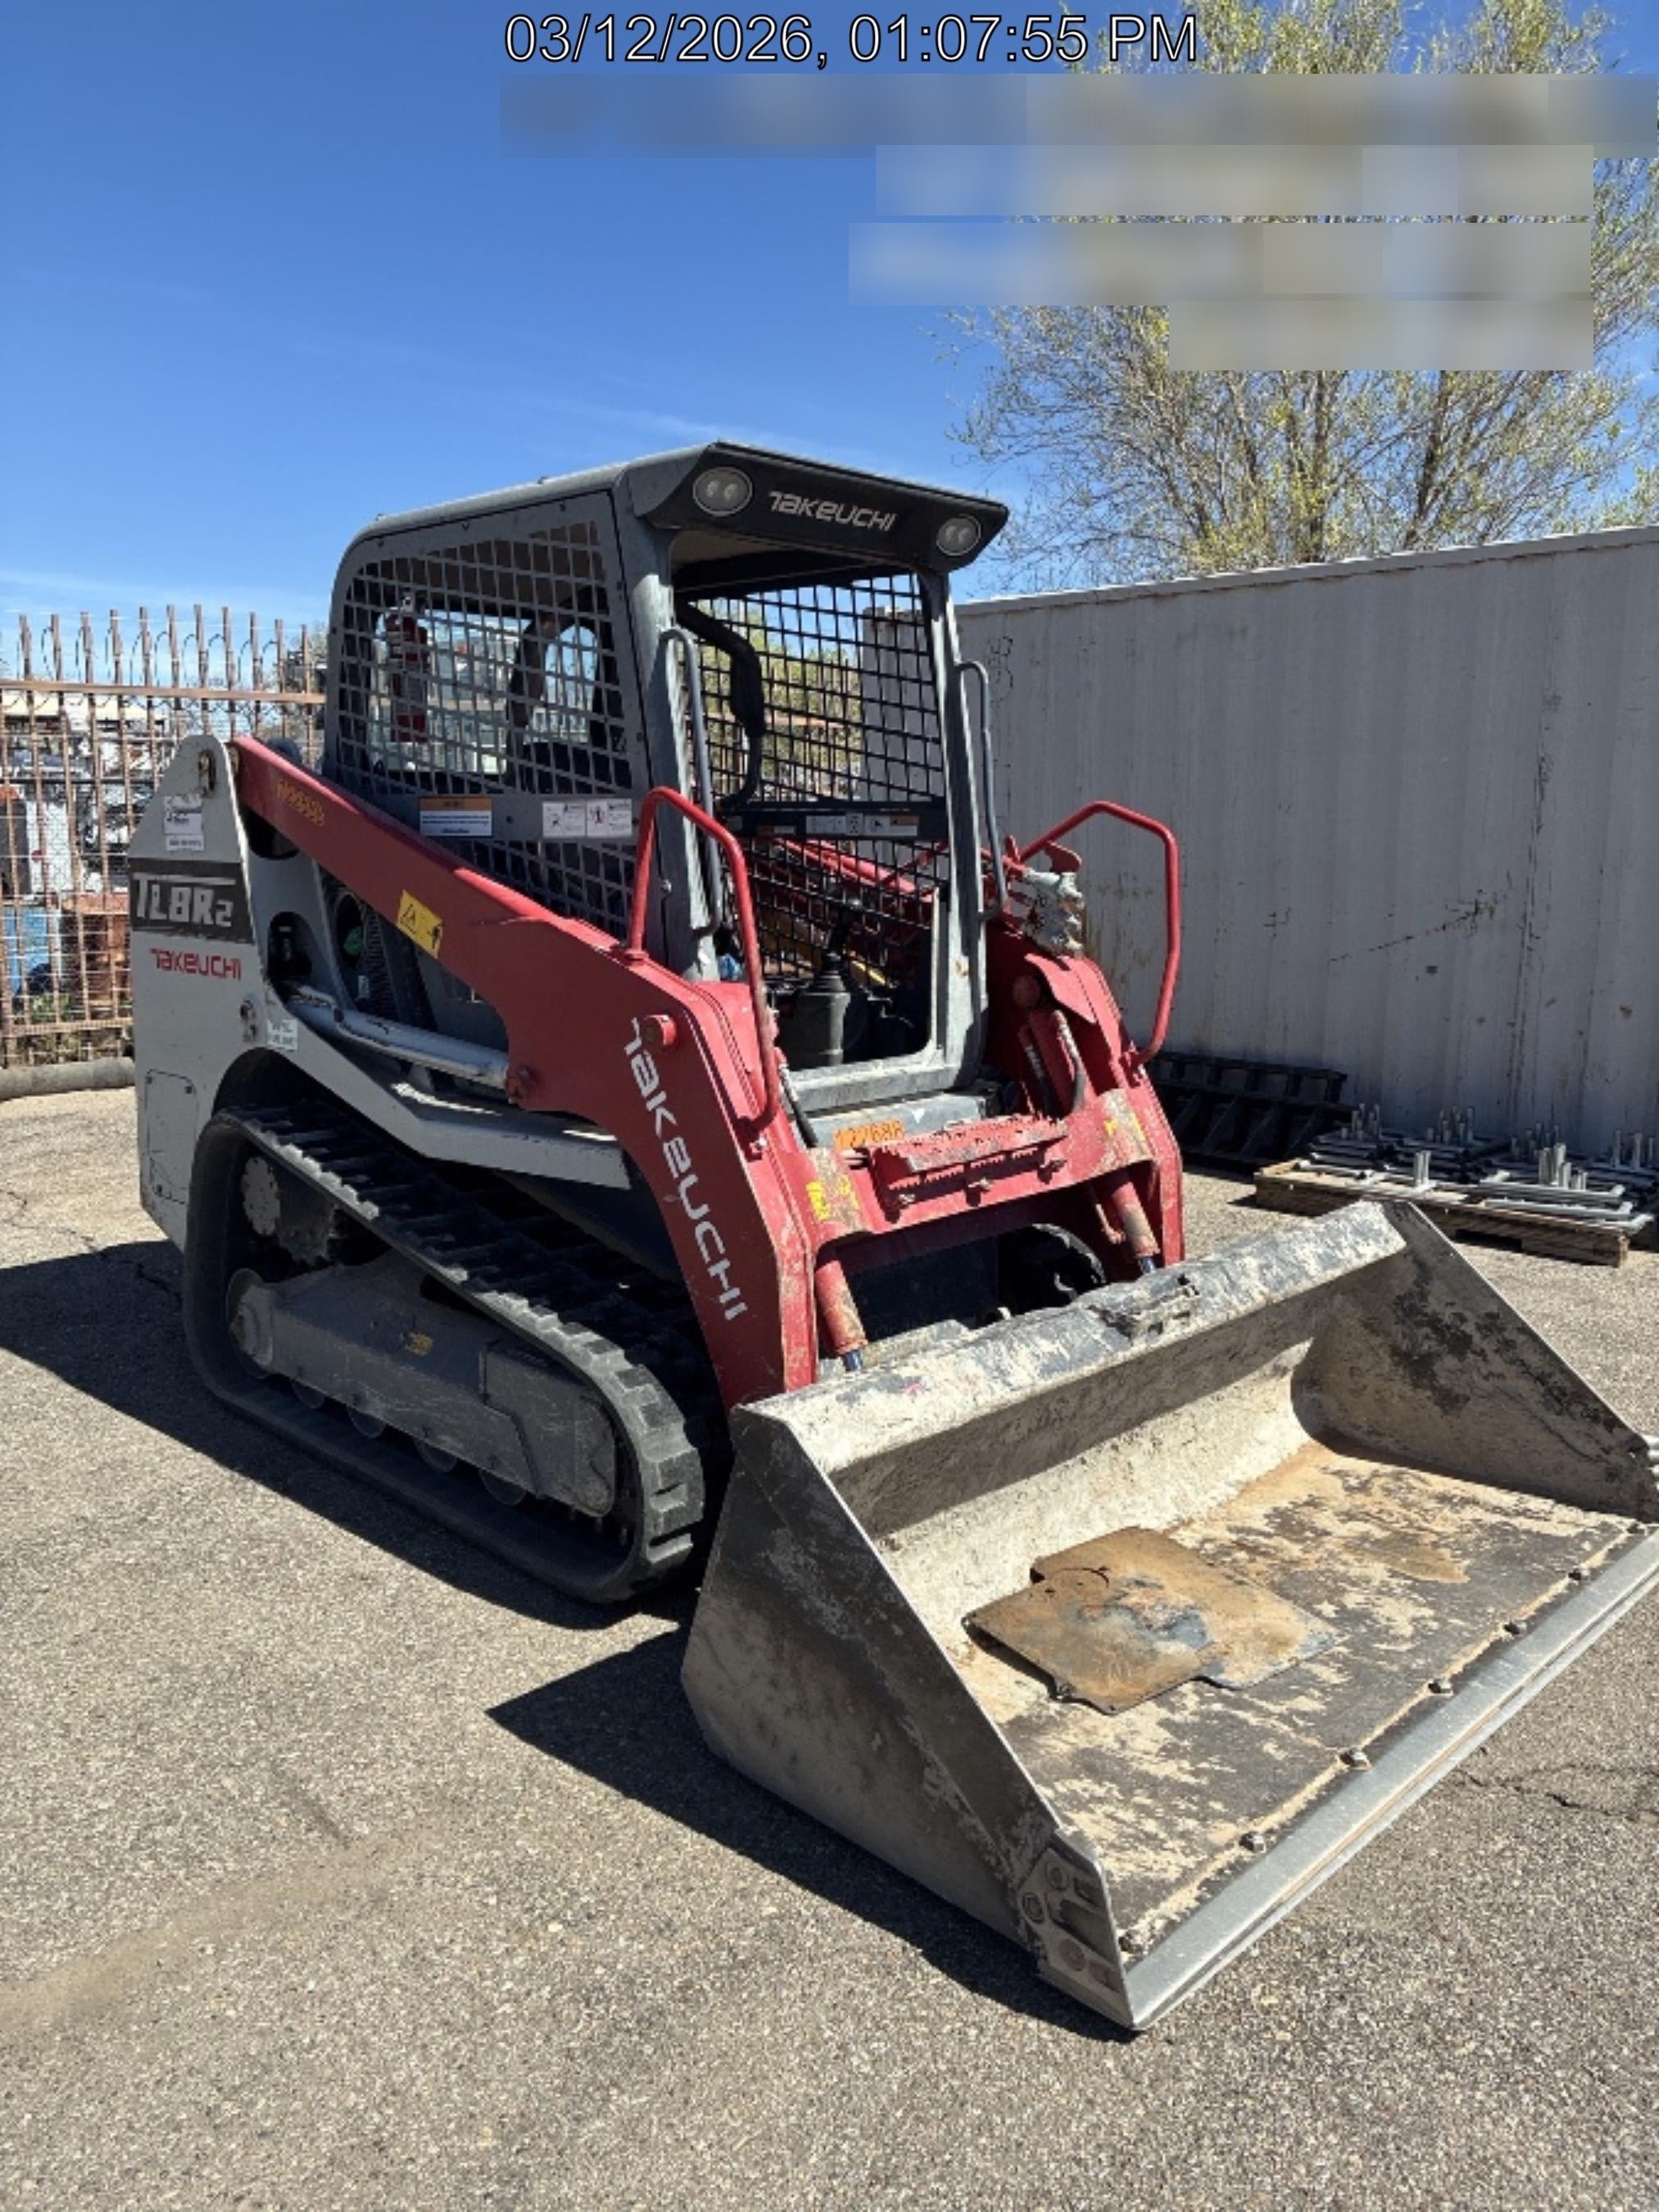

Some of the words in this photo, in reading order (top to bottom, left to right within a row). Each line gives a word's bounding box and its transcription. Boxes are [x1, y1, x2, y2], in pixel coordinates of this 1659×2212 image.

[768, 491, 898, 532] TAKEUCHI
[151, 947, 242, 981] TAKEUCHI
[623, 1016, 749, 1321] TAKEUCHI
